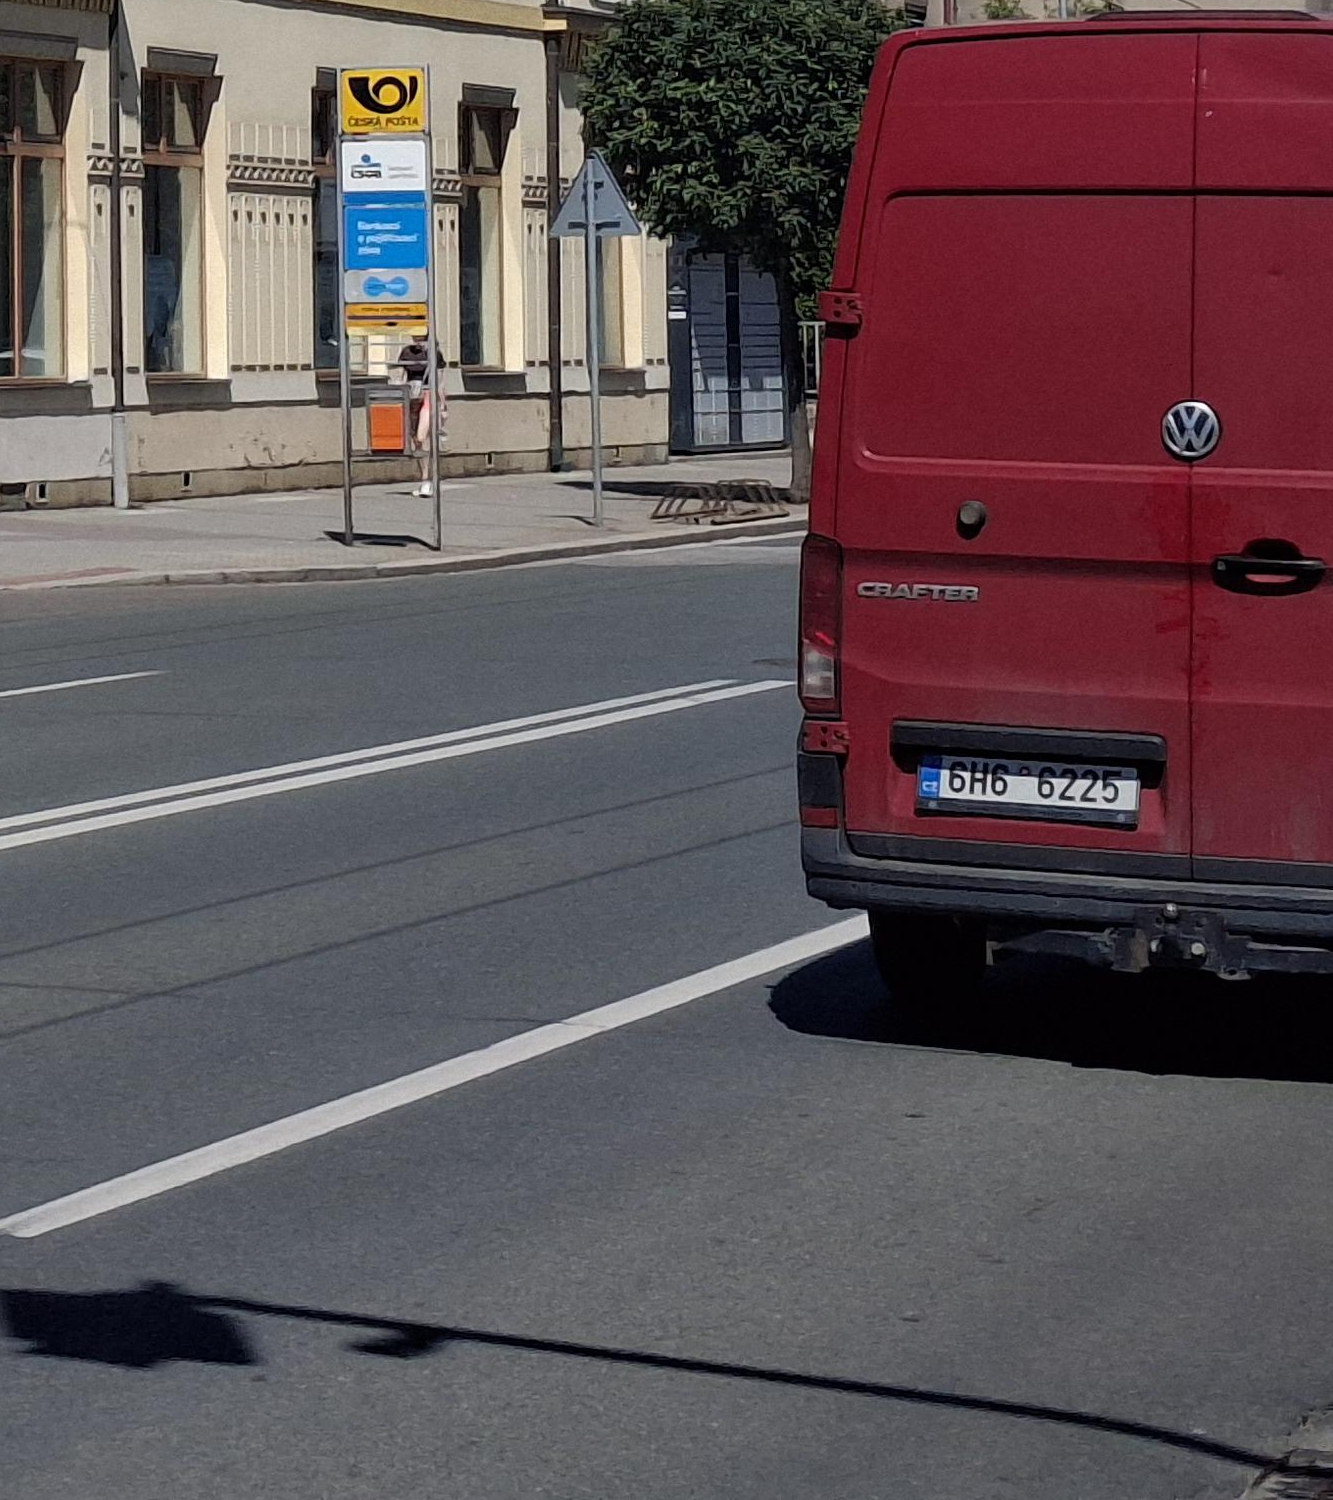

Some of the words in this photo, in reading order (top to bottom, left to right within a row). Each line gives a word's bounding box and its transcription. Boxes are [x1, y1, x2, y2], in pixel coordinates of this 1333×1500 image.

[1164, 404, 1217, 454] VW
[856, 581, 980, 602] CRAFTER
[947, 760, 1010, 797] 6H6
[1036, 766, 1123, 804] 6225
